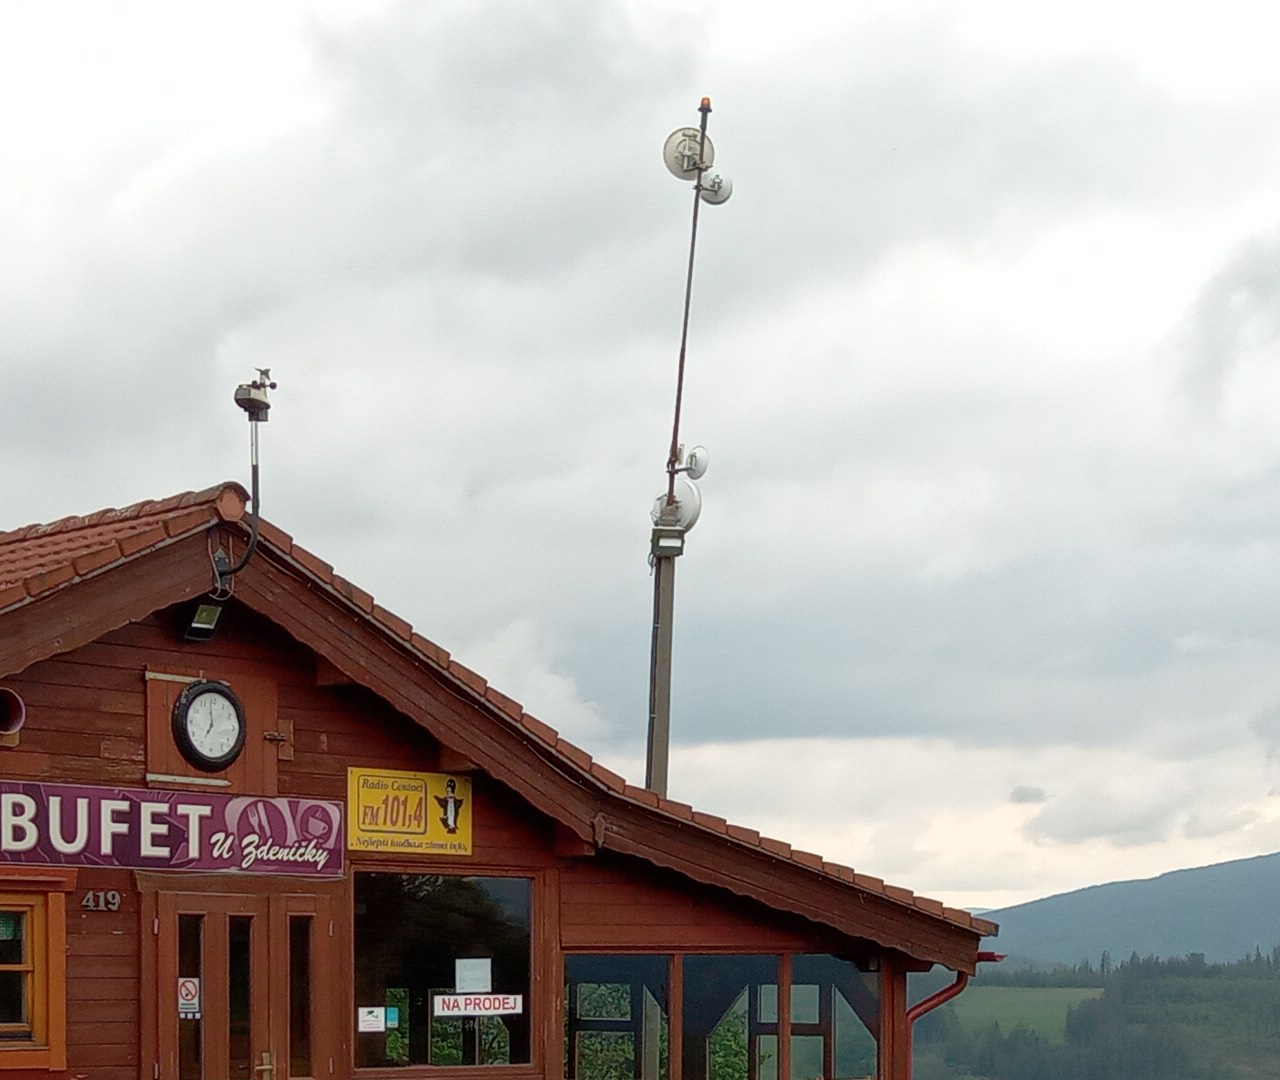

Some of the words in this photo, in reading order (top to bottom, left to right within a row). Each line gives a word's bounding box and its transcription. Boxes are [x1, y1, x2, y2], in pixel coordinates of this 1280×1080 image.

[361, 778, 389, 791] Radio
[361, 804, 381, 827] FM
[382, 794, 424, 829] 101,4
[0, 792, 214, 860] BUFET
[210, 832, 234, 859] U
[241, 833, 330, 871] Zdeničky
[81, 889, 121, 911] 419
[441, 997, 461, 1011] NA
[464, 997, 517, 1011] PRODEJ
